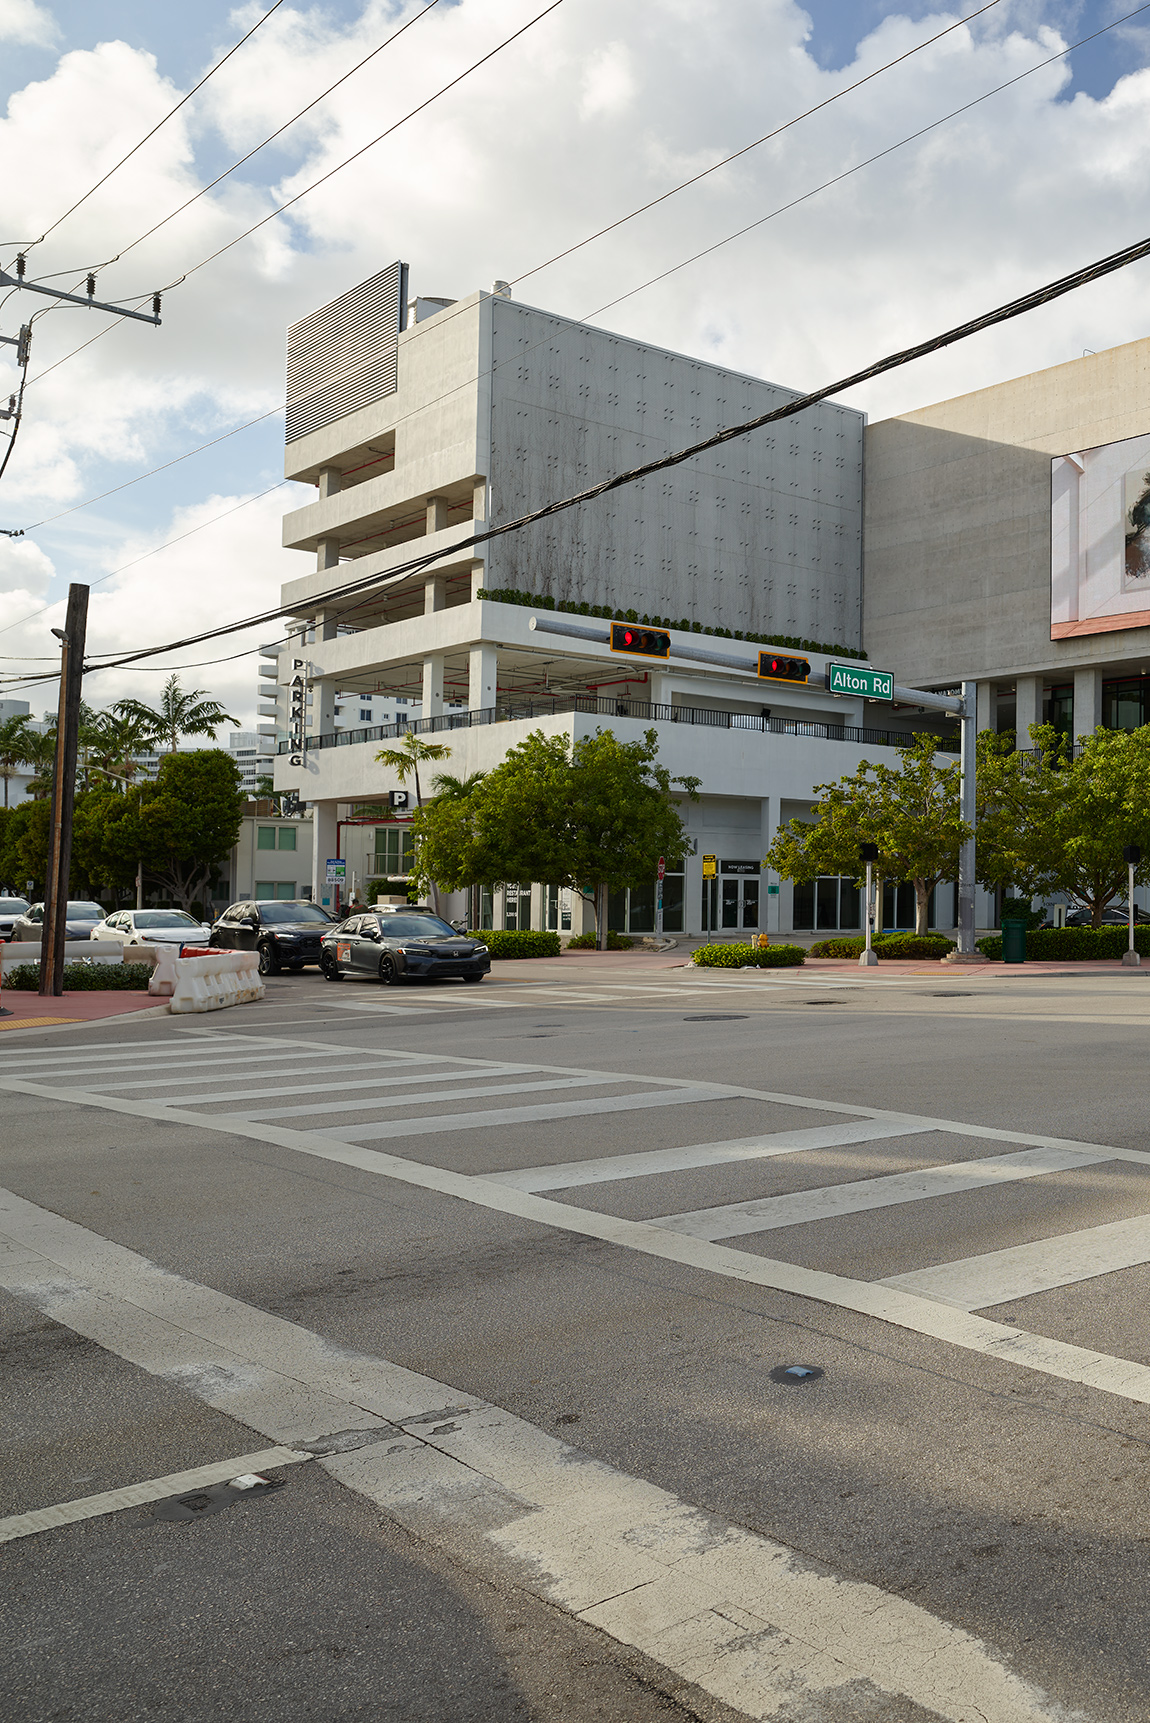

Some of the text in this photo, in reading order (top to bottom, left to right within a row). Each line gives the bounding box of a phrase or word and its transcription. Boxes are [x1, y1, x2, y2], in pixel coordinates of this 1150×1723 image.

[833, 672, 890, 694] Alton Rd
[288, 658, 303, 767] PARKING
[394, 792, 406, 806] P
